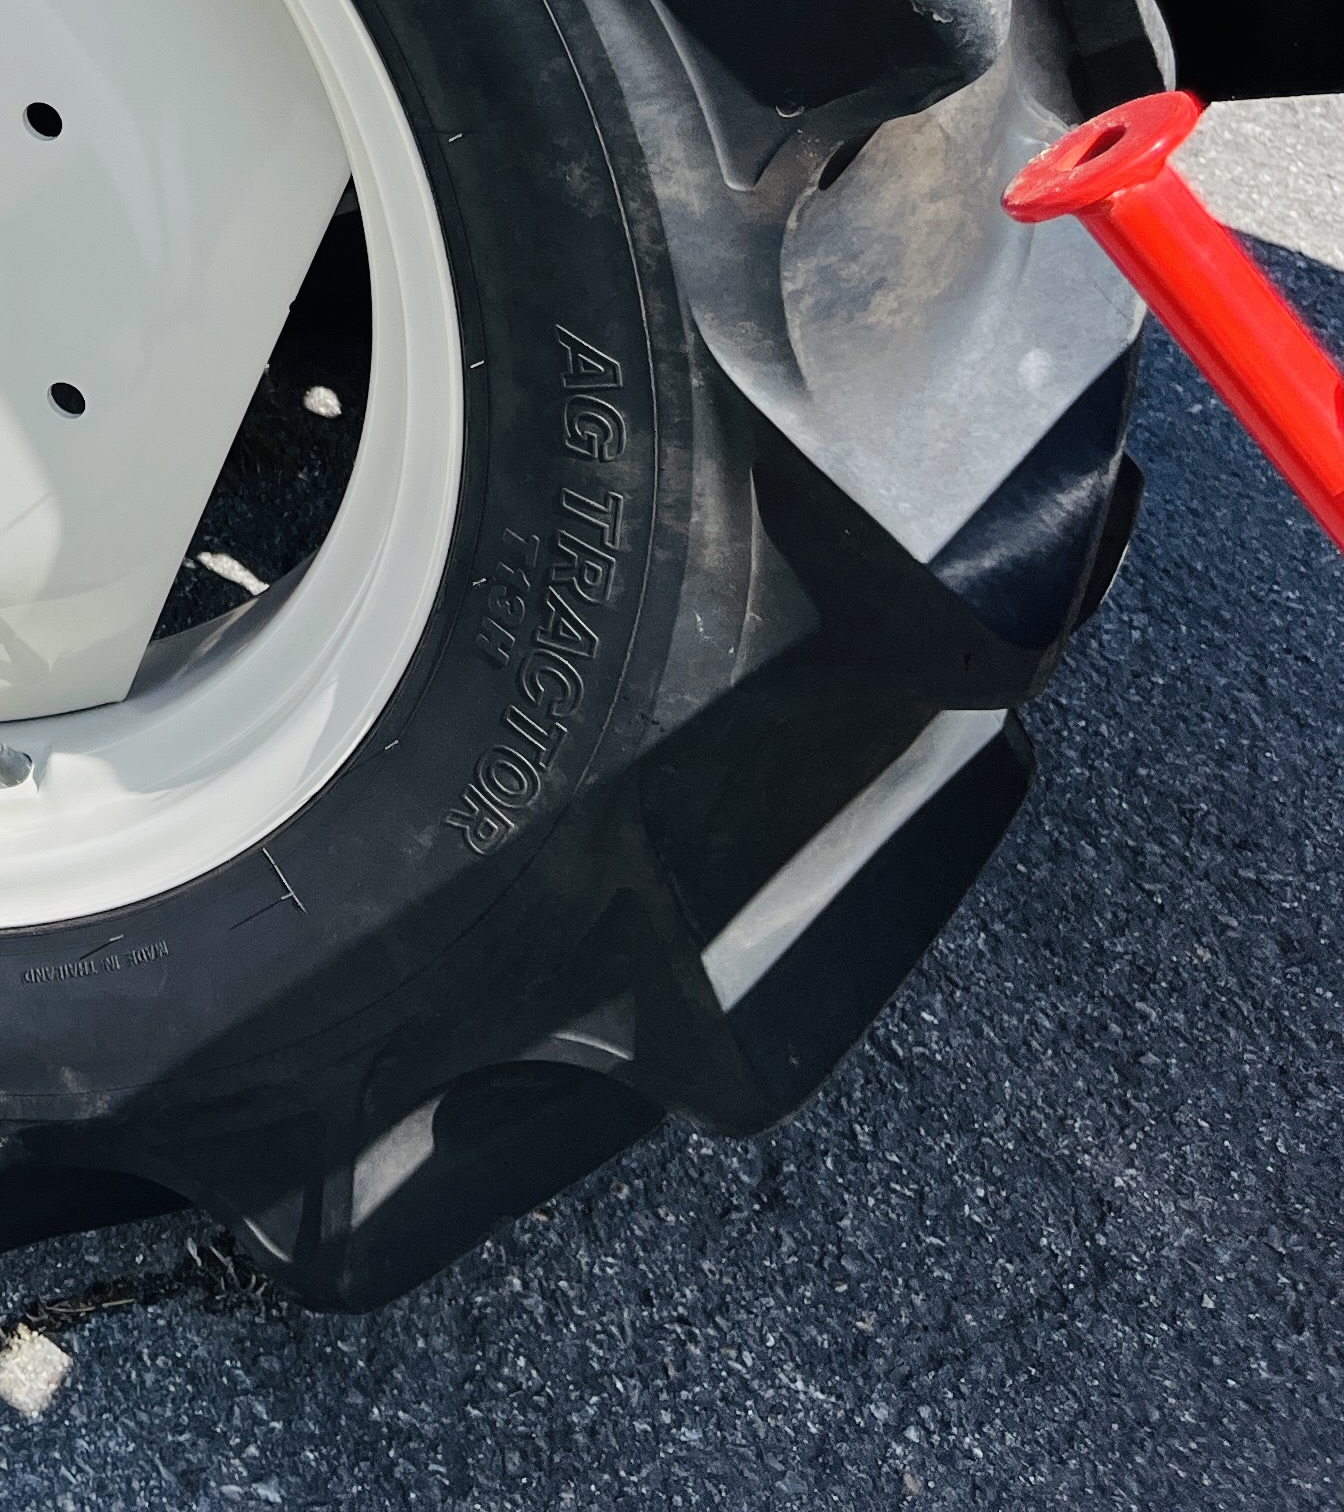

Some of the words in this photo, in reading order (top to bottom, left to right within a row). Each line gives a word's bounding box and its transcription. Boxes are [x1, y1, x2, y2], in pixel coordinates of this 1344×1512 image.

[555, 324, 627, 463] AG
[445, 487, 624, 856] TRACTOR
[103, 955, 121, 972] IN
[126, 940, 169, 966] MADE
[23, 960, 99, 985] THAILAND
